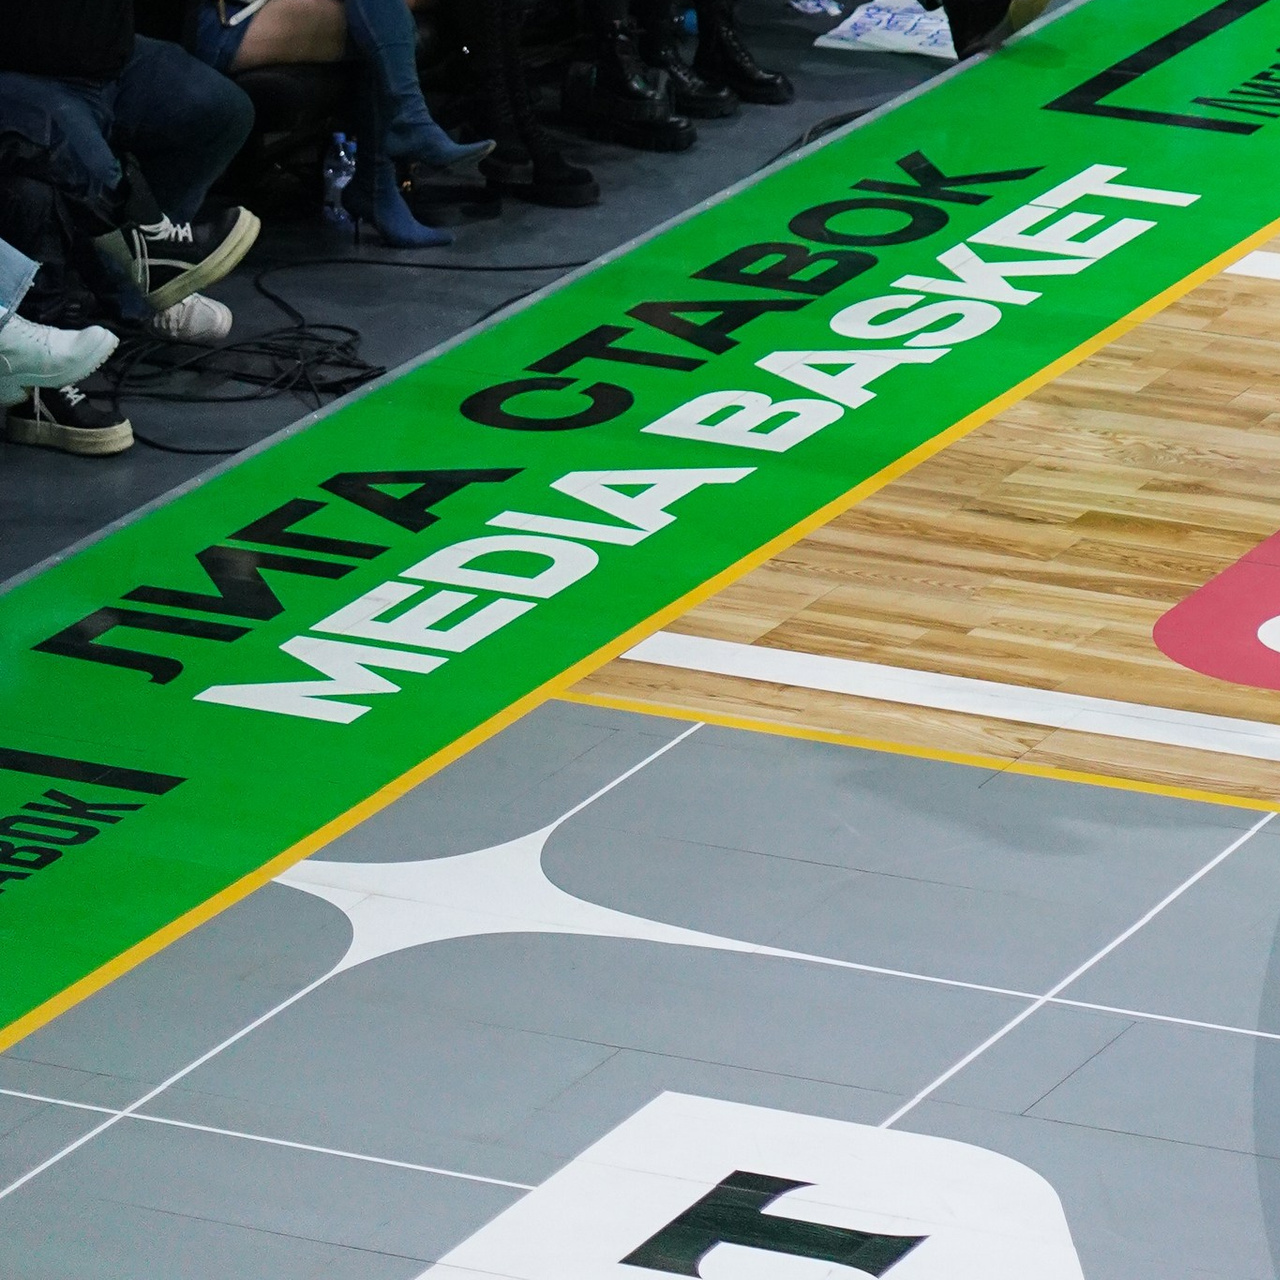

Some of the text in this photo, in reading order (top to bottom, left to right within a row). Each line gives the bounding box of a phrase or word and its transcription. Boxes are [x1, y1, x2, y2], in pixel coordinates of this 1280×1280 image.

[34, 150, 1045, 685] ЛИГА СТАВОК
[193, 164, 1202, 724] MEDIA BASKET
